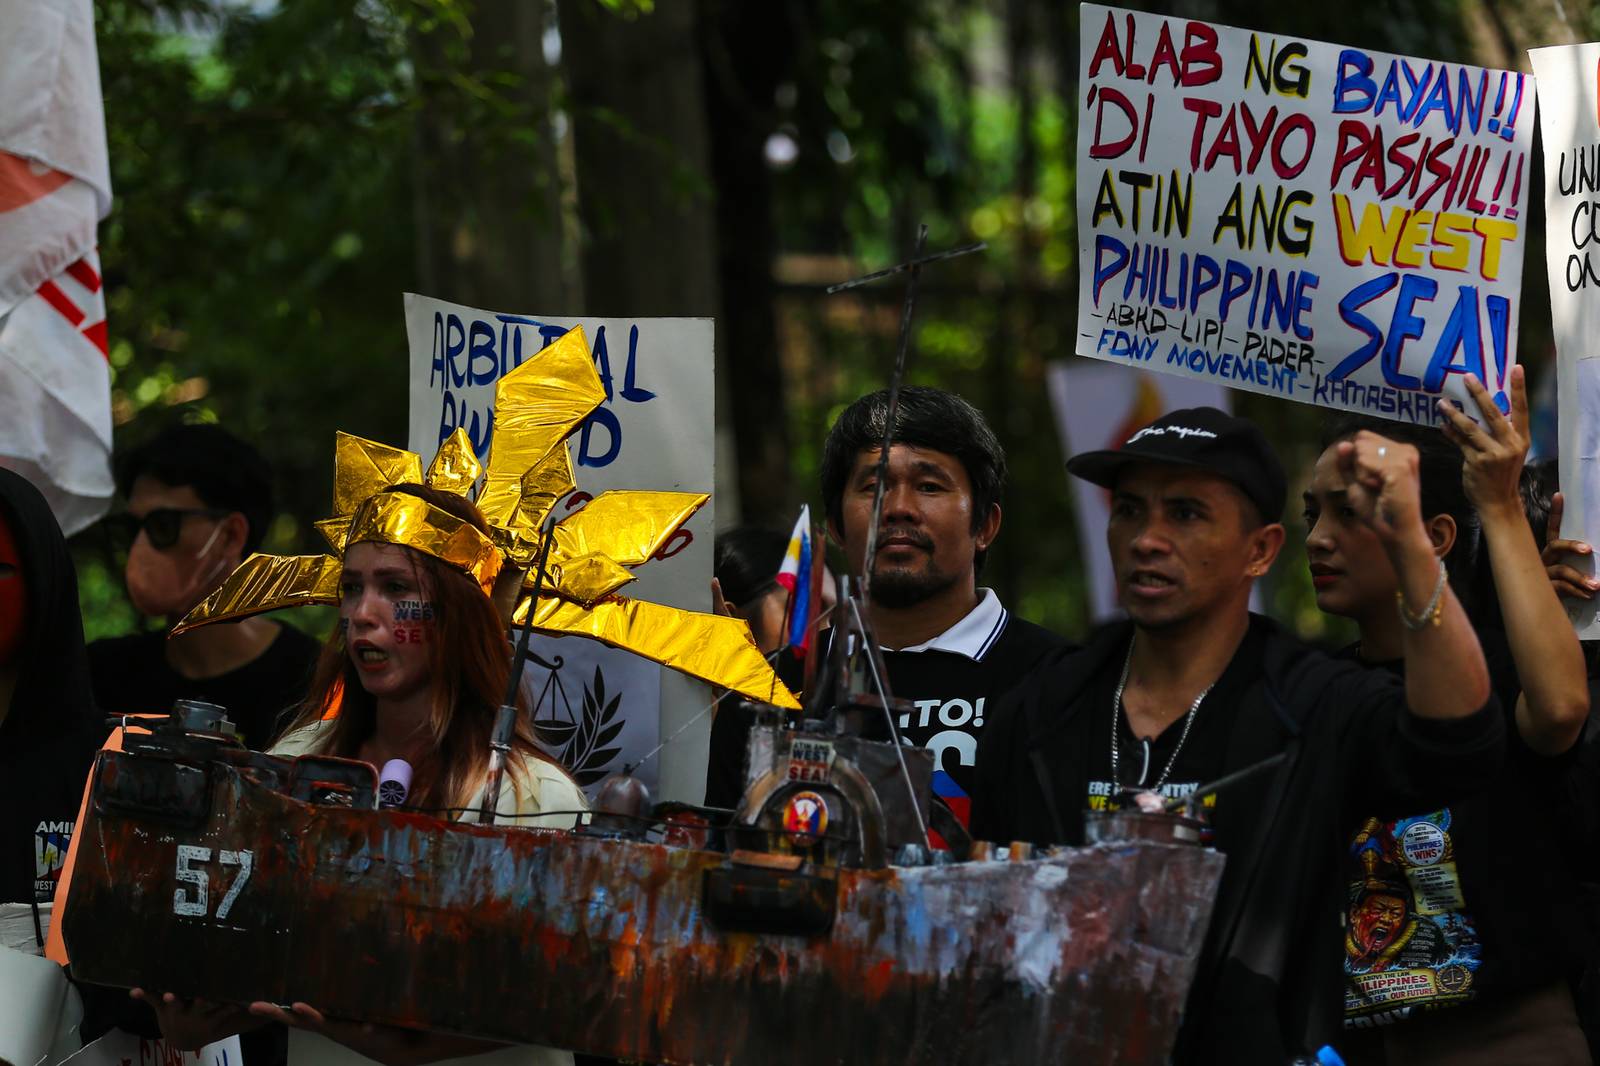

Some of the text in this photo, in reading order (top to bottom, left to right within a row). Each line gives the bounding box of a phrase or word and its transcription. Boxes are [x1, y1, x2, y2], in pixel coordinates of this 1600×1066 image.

[1089, 10, 1222, 87] ALAB
[1244, 33, 1311, 99] NG
[1332, 50, 1525, 142] BAYAN!!
[1183, 98, 1316, 180] TAYO
[1092, 168, 1518, 281] ATIN ANG WEST
[1093, 234, 1512, 416] PHILIPPINE SEA!
[793, 750, 828, 760] WEST
[174, 845, 254, 919] 57
[1406, 840, 1442, 852] PHILIPPINES
[1413, 849, 1438, 860] WINS
[1391, 992, 1405, 1000] OUR
